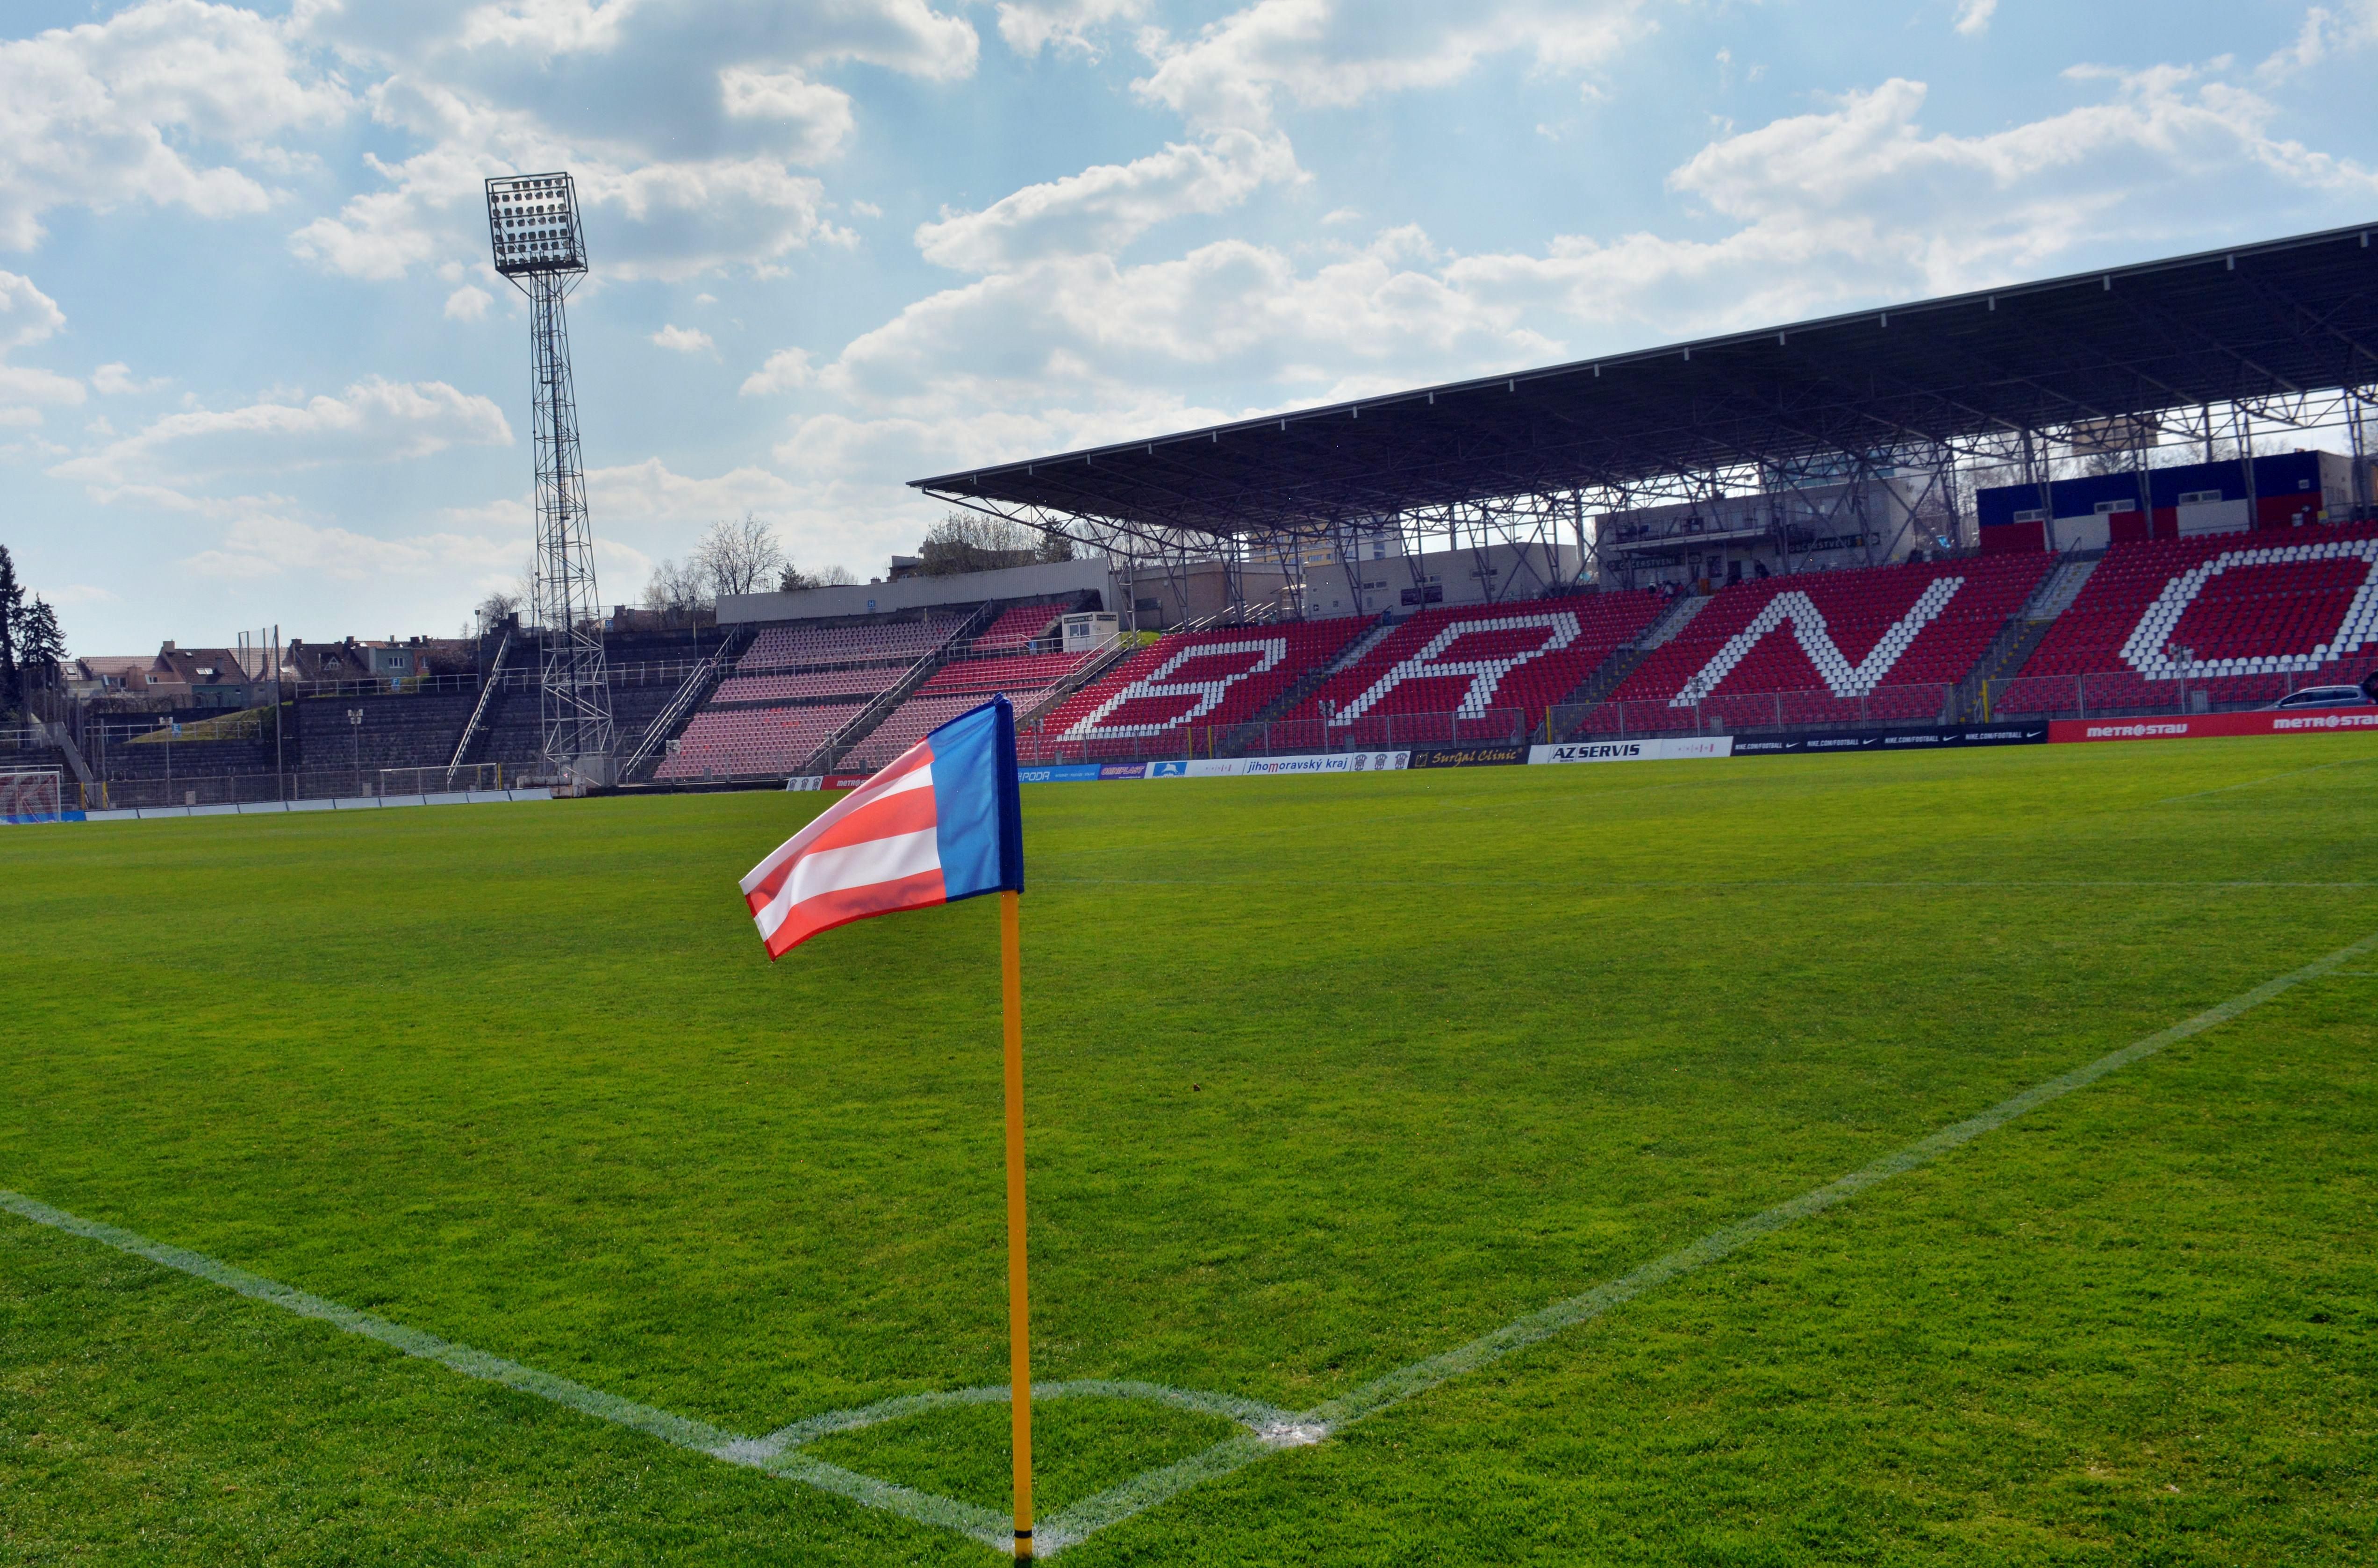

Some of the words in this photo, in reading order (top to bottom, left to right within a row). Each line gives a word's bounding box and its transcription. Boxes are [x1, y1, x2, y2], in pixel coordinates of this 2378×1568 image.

[1477, 749, 1517, 761] Clinic
[1552, 747, 1576, 759] AZ
[1578, 744, 1640, 758] SERVIS
[1101, 766, 1145, 775] OMNIPLAST
[1247, 759, 1322, 773] jihomoravský
[1325, 758, 1348, 769] kraj
[1022, 772, 1050, 781] PODA
